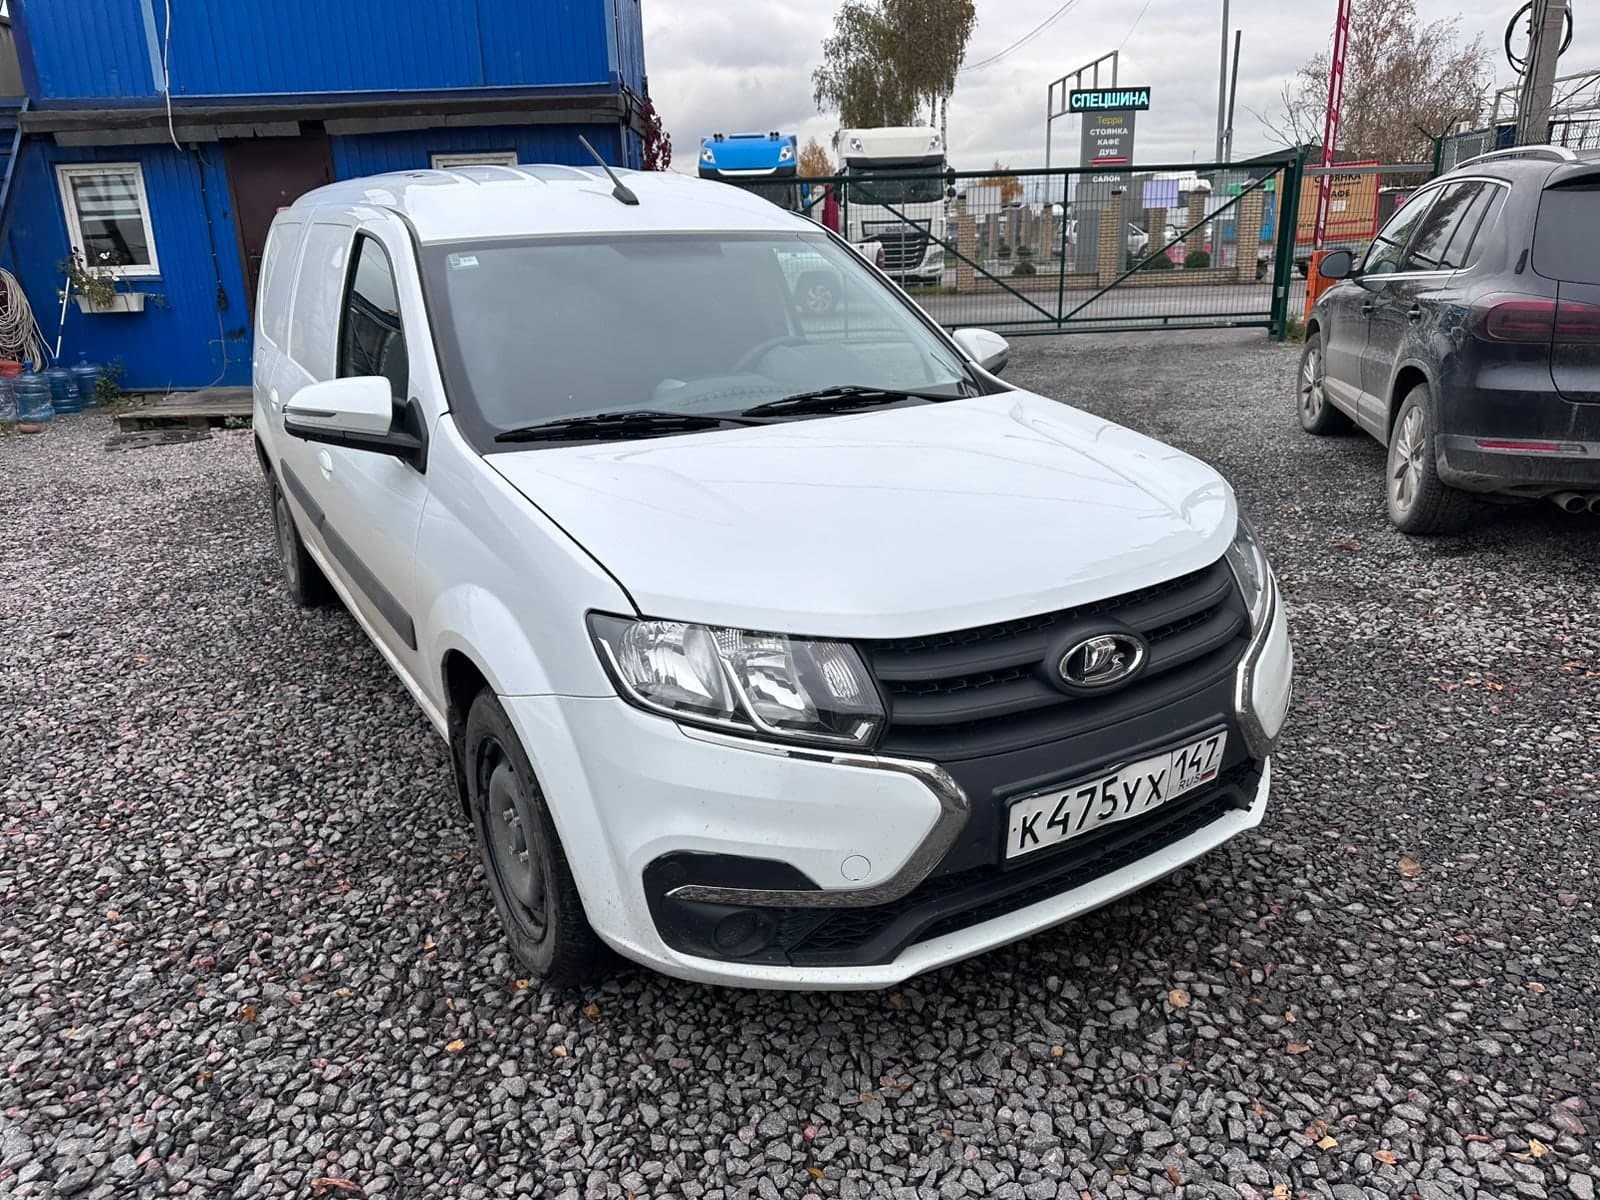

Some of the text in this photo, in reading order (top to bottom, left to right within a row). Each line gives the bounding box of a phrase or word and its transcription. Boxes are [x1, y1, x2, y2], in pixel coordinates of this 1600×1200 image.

[1072, 91, 1149, 108] СПЕЦШИНА
[1090, 127, 1128, 136] СТОЯНКА
[1097, 138, 1120, 146] КАФЕ
[1099, 148, 1118, 156] ДУШ
[1092, 175, 1121, 183] САЛОН
[1331, 190, 1350, 198] АФЕ
[1178, 773, 1200, 791] RUS
[1019, 736, 1220, 849] К475УХ 147
